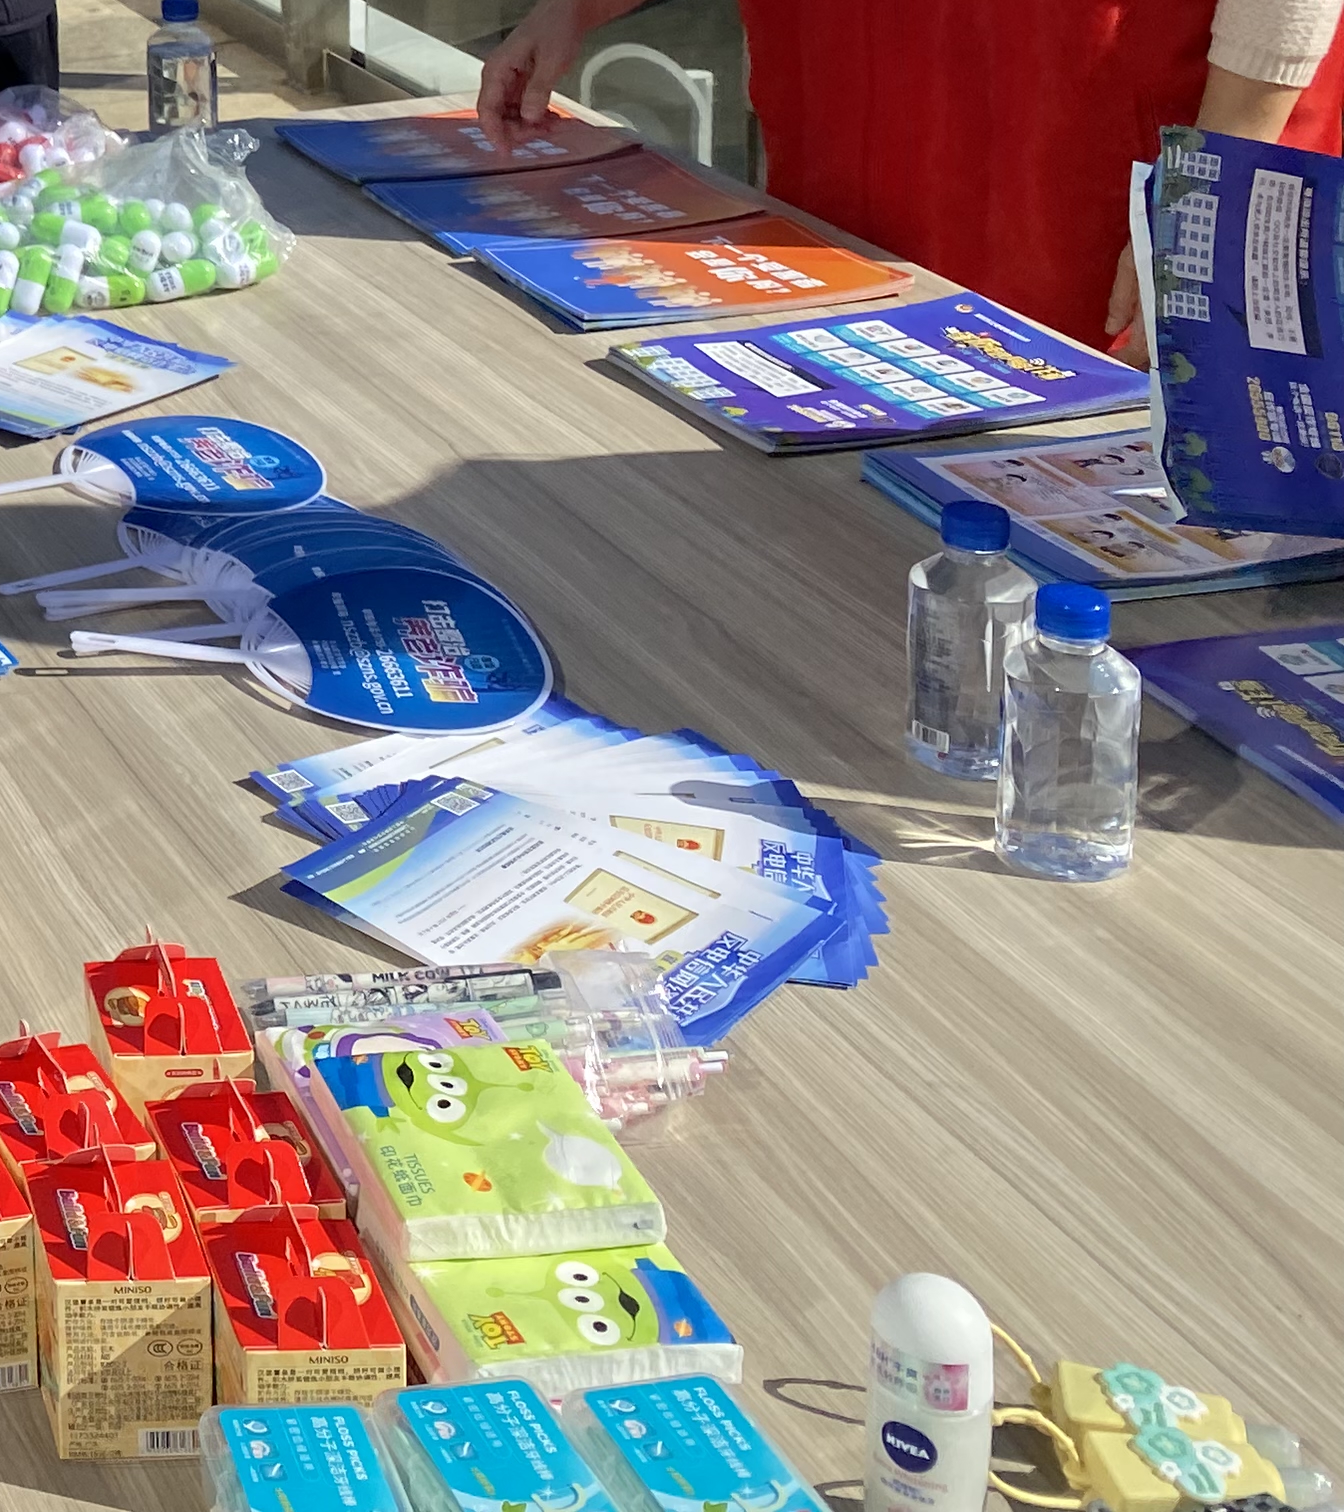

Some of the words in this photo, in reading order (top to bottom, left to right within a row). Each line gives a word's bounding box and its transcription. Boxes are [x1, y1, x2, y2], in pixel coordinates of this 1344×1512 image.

[372, 971, 412, 984] MILK
[414, 967, 452, 982] COW
[465, 1017, 494, 1041] TOY
[518, 1045, 555, 1074] TOY
[380, 1145, 423, 1207] 印花纸面巾
[404, 1152, 435, 1195] TISSUES
[113, 1286, 152, 1295] MINISO
[467, 1313, 500, 1350] TOY
[164, 1360, 201, 1371] 合格证
[309, 1355, 349, 1364] MINISO
[507, 1390, 536, 1422] FLOSS
[524, 1420, 558, 1454] PICKS
[693, 1387, 724, 1420] FLOSS
[719, 1418, 752, 1452] PICKS
[333, 1416, 354, 1448] FLOSS
[347, 1448, 368, 1481] PICKS
[886, 1432, 931, 1460] NIVEA
